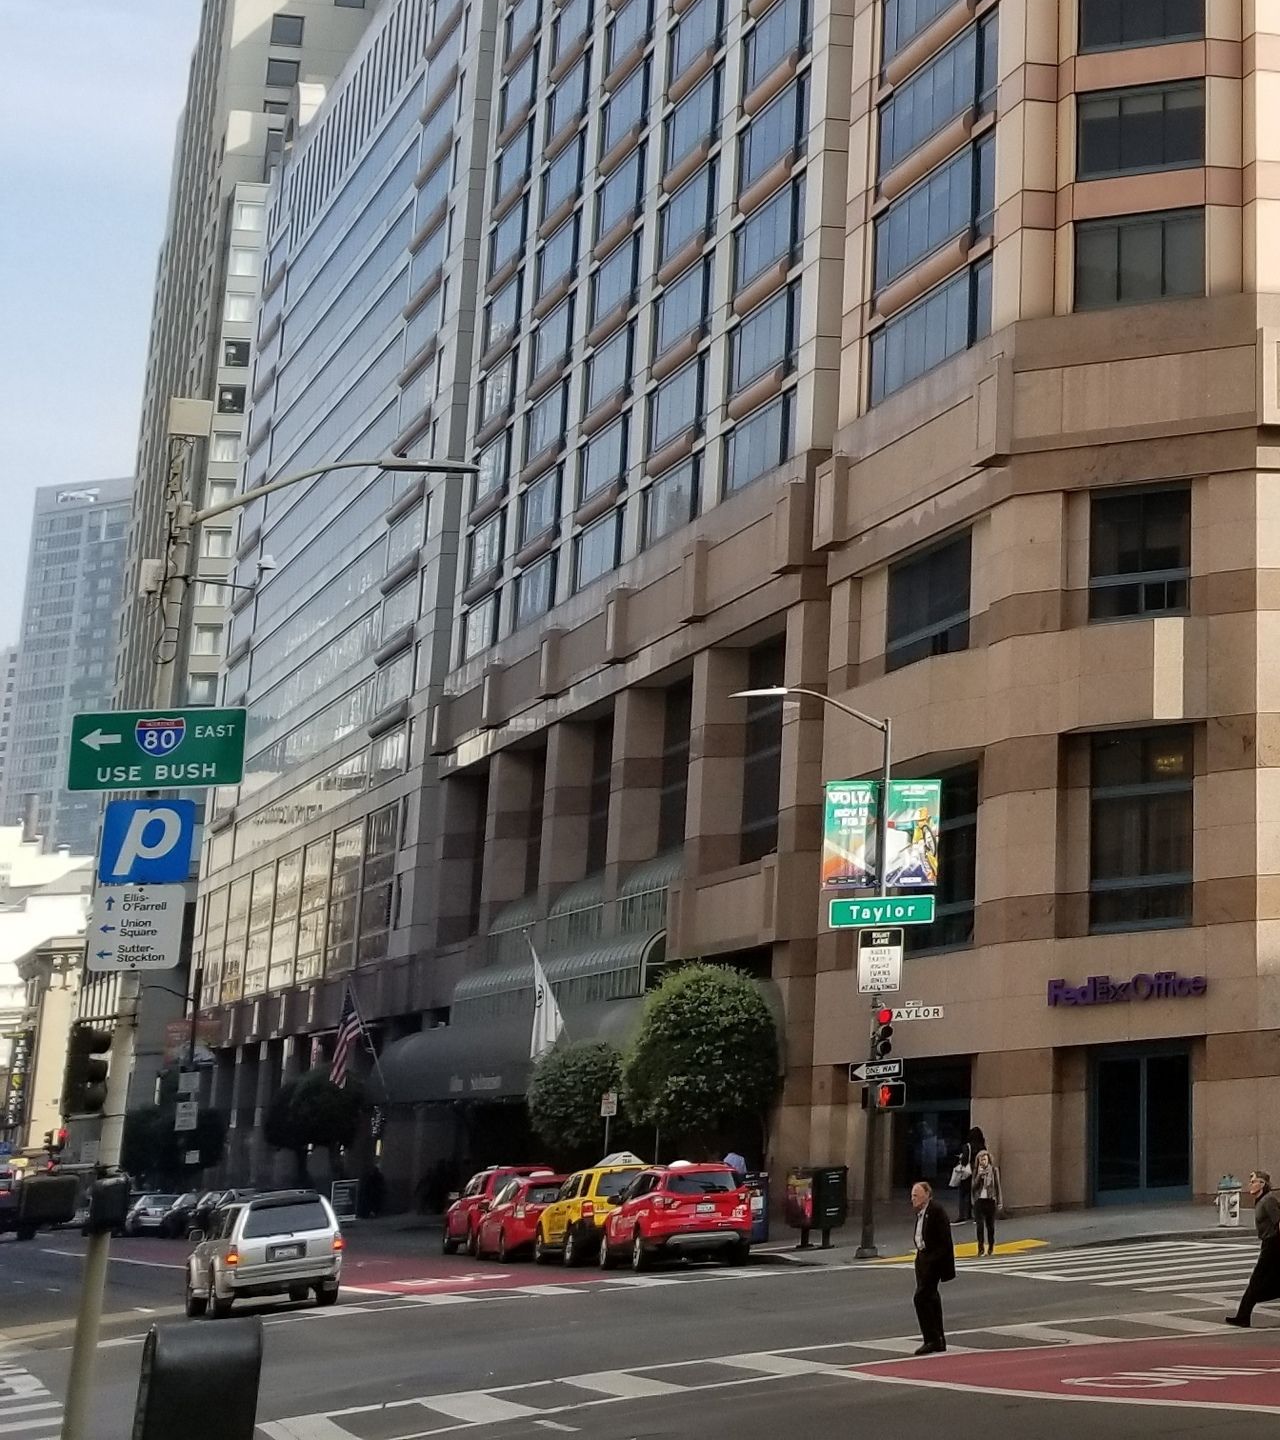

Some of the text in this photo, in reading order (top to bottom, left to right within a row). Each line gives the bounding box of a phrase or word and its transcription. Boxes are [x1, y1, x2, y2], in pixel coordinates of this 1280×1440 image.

[144, 725, 235, 749] 80 EAST
[97, 763, 217, 782] USE BUSH
[122, 902, 167, 911] O'Farrell
[849, 904, 915, 921] Taylor
[121, 919, 152, 928] Union
[119, 928, 158, 938] Square
[117, 944, 155, 954] Sutter-
[116, 953, 165, 963] Stockton
[895, 1008, 940, 1020] AYLOR
[865, 1063, 897, 1075] ONE WAY
[389, 1272, 512, 1286] BUS
